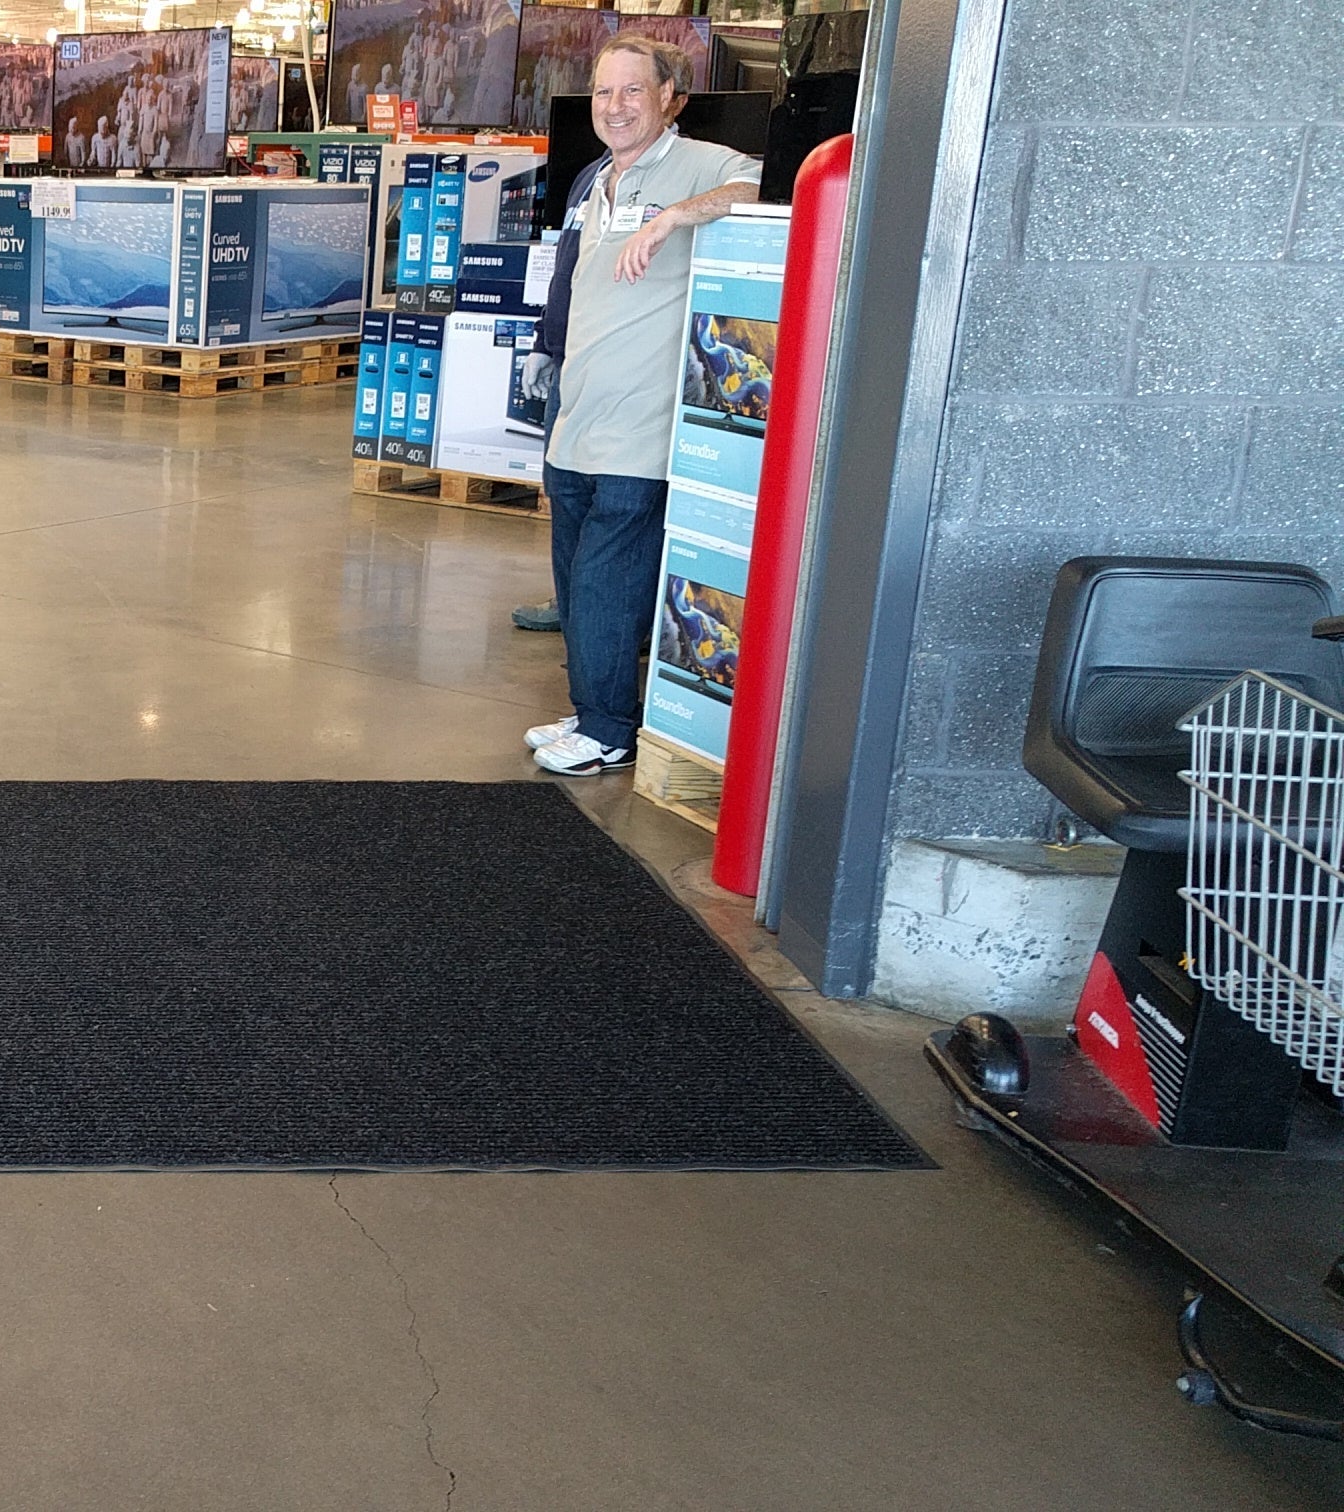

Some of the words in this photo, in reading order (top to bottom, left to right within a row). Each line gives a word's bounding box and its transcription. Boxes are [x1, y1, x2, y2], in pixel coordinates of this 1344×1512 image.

[64, 46, 79, 56] HD
[215, 195, 243, 203] SAMSUNG
[212, 232, 240, 246] Curved
[10, 239, 25, 253] TV
[212, 247, 236, 263] UHD
[236, 247, 249, 262] TV
[463, 256, 503, 266] SAMSUNG
[461, 293, 501, 303] SAMSUNG
[454, 322, 494, 333] SAMSUNG
[678, 438, 720, 461] Soundbar
[652, 692, 694, 721] Soundbar
